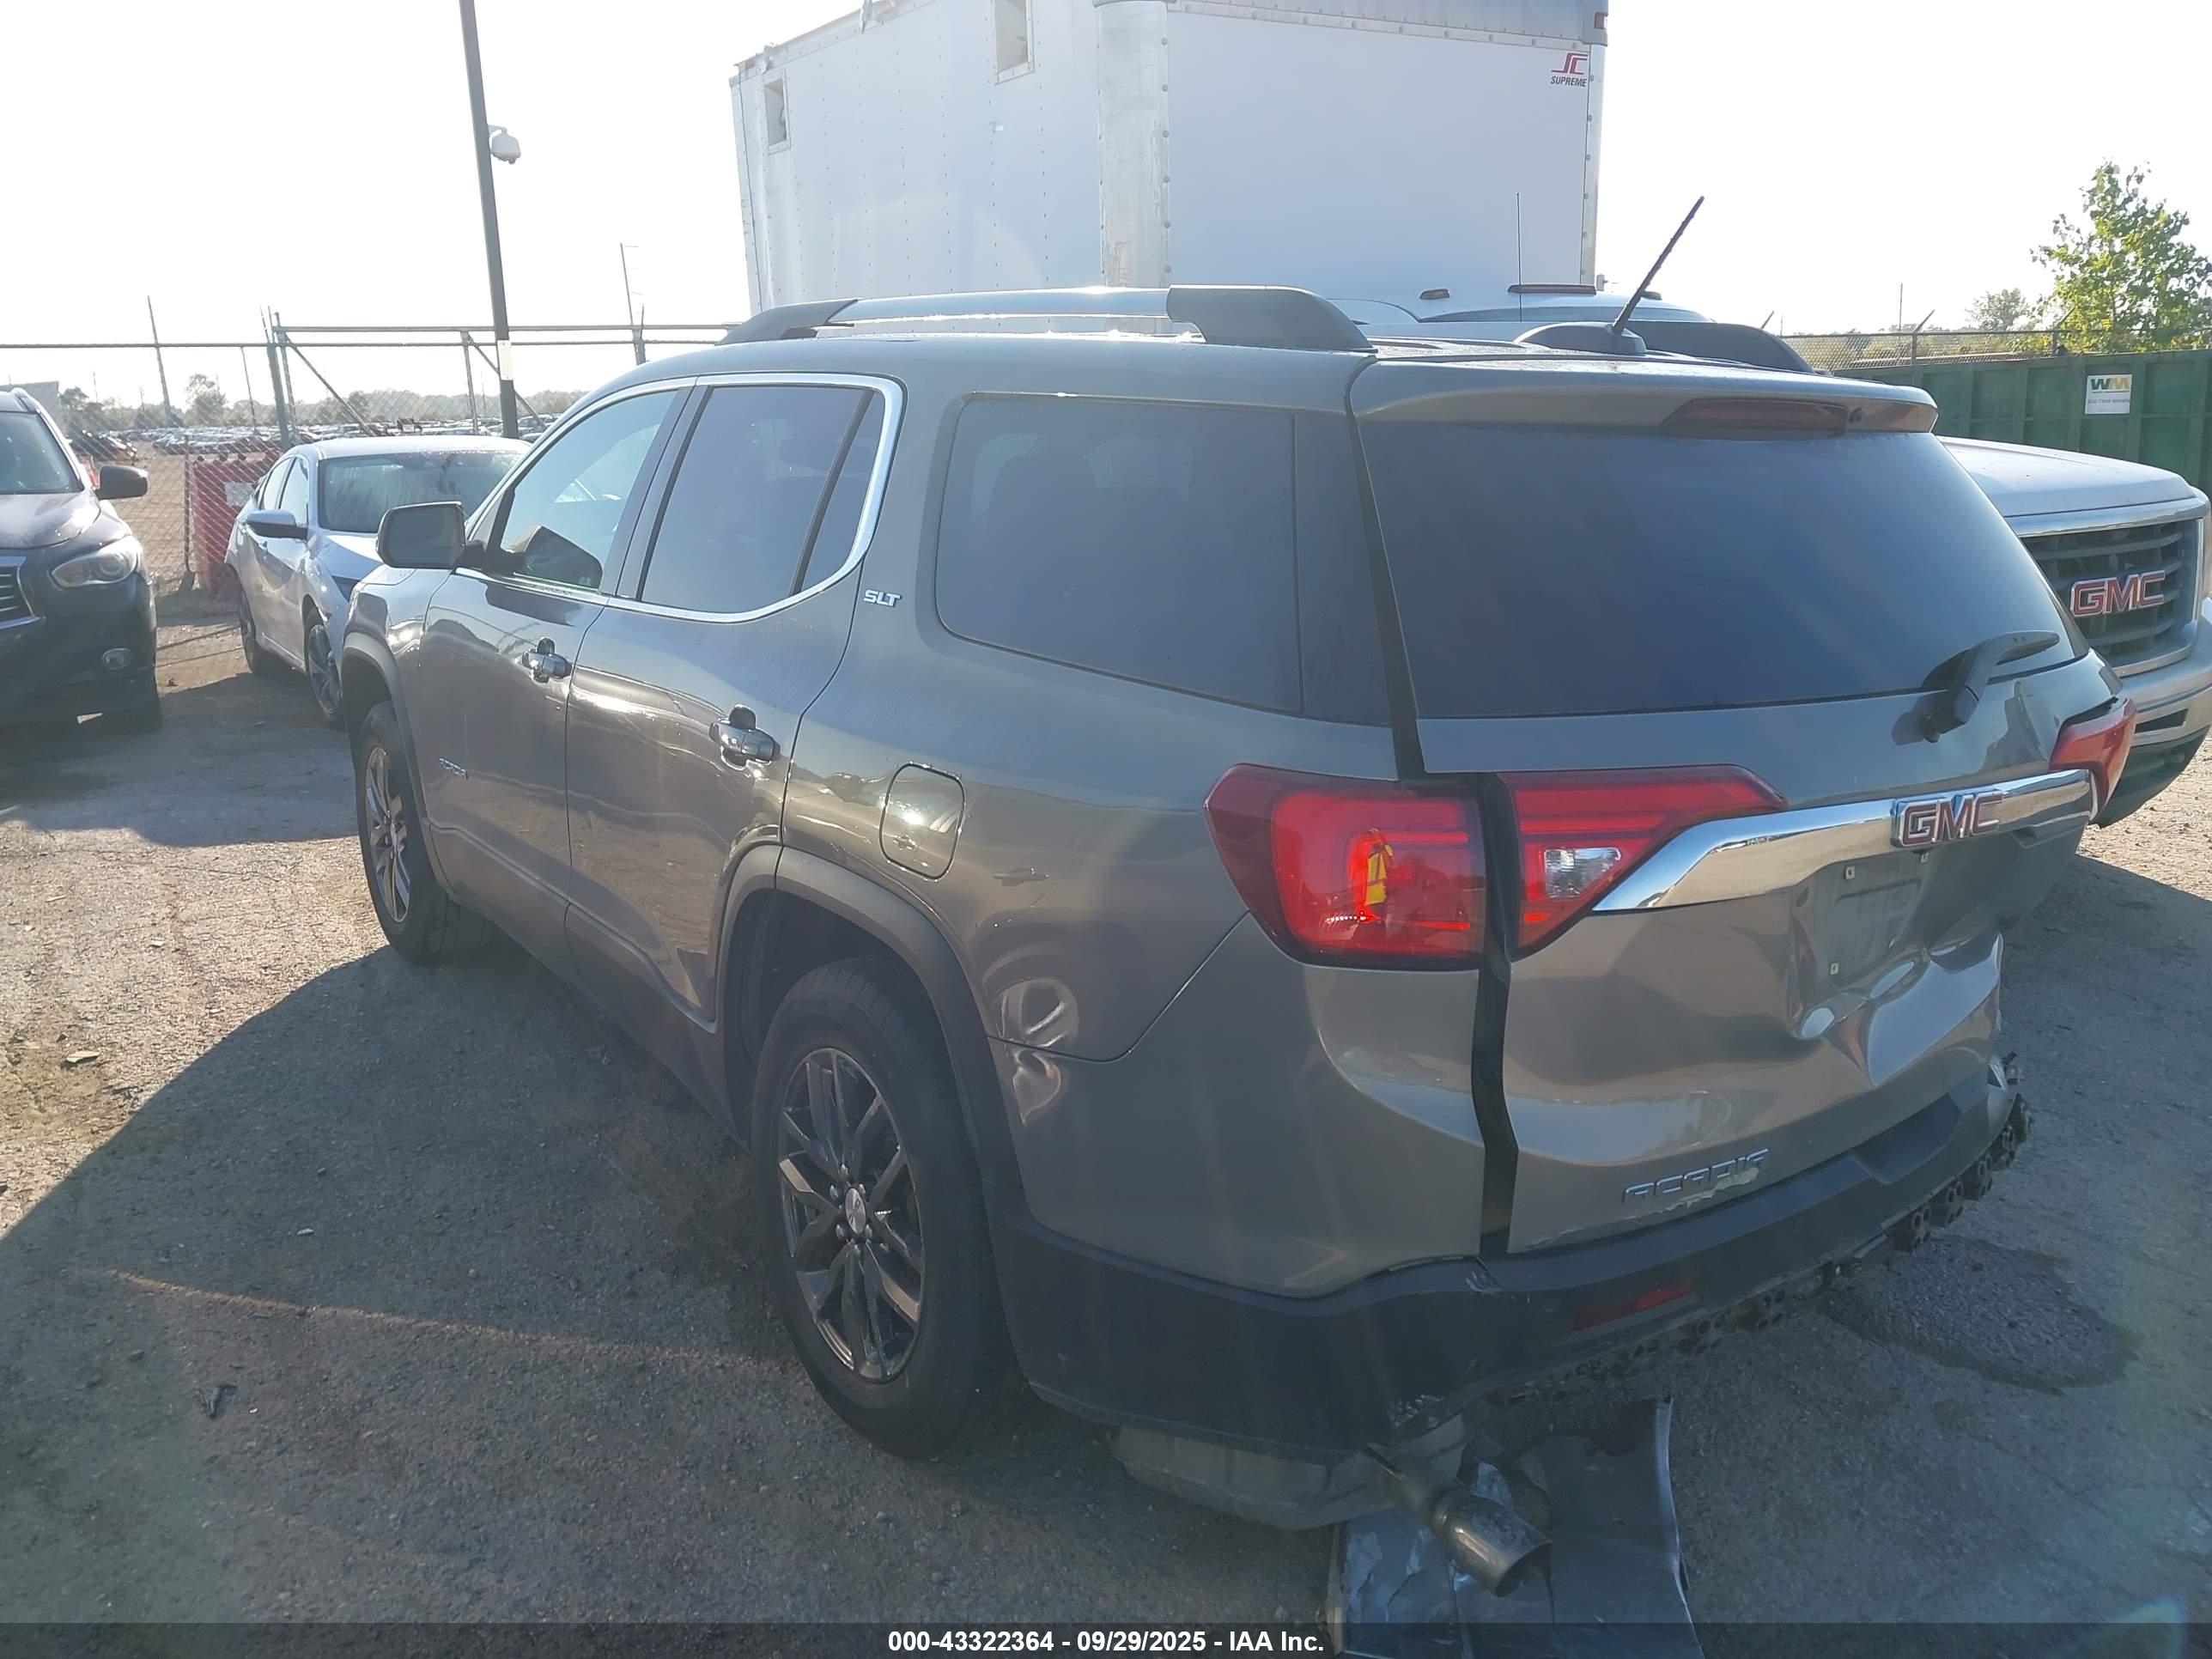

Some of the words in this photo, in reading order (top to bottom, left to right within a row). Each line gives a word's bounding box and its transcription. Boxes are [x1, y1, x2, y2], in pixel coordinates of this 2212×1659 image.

[1550, 75, 1588, 88] SUPREME
[2090, 378, 2130, 391] WM
[863, 589, 901, 607] SLT
[2070, 569, 2166, 617] GMC
[1898, 790, 2003, 847] GMC
